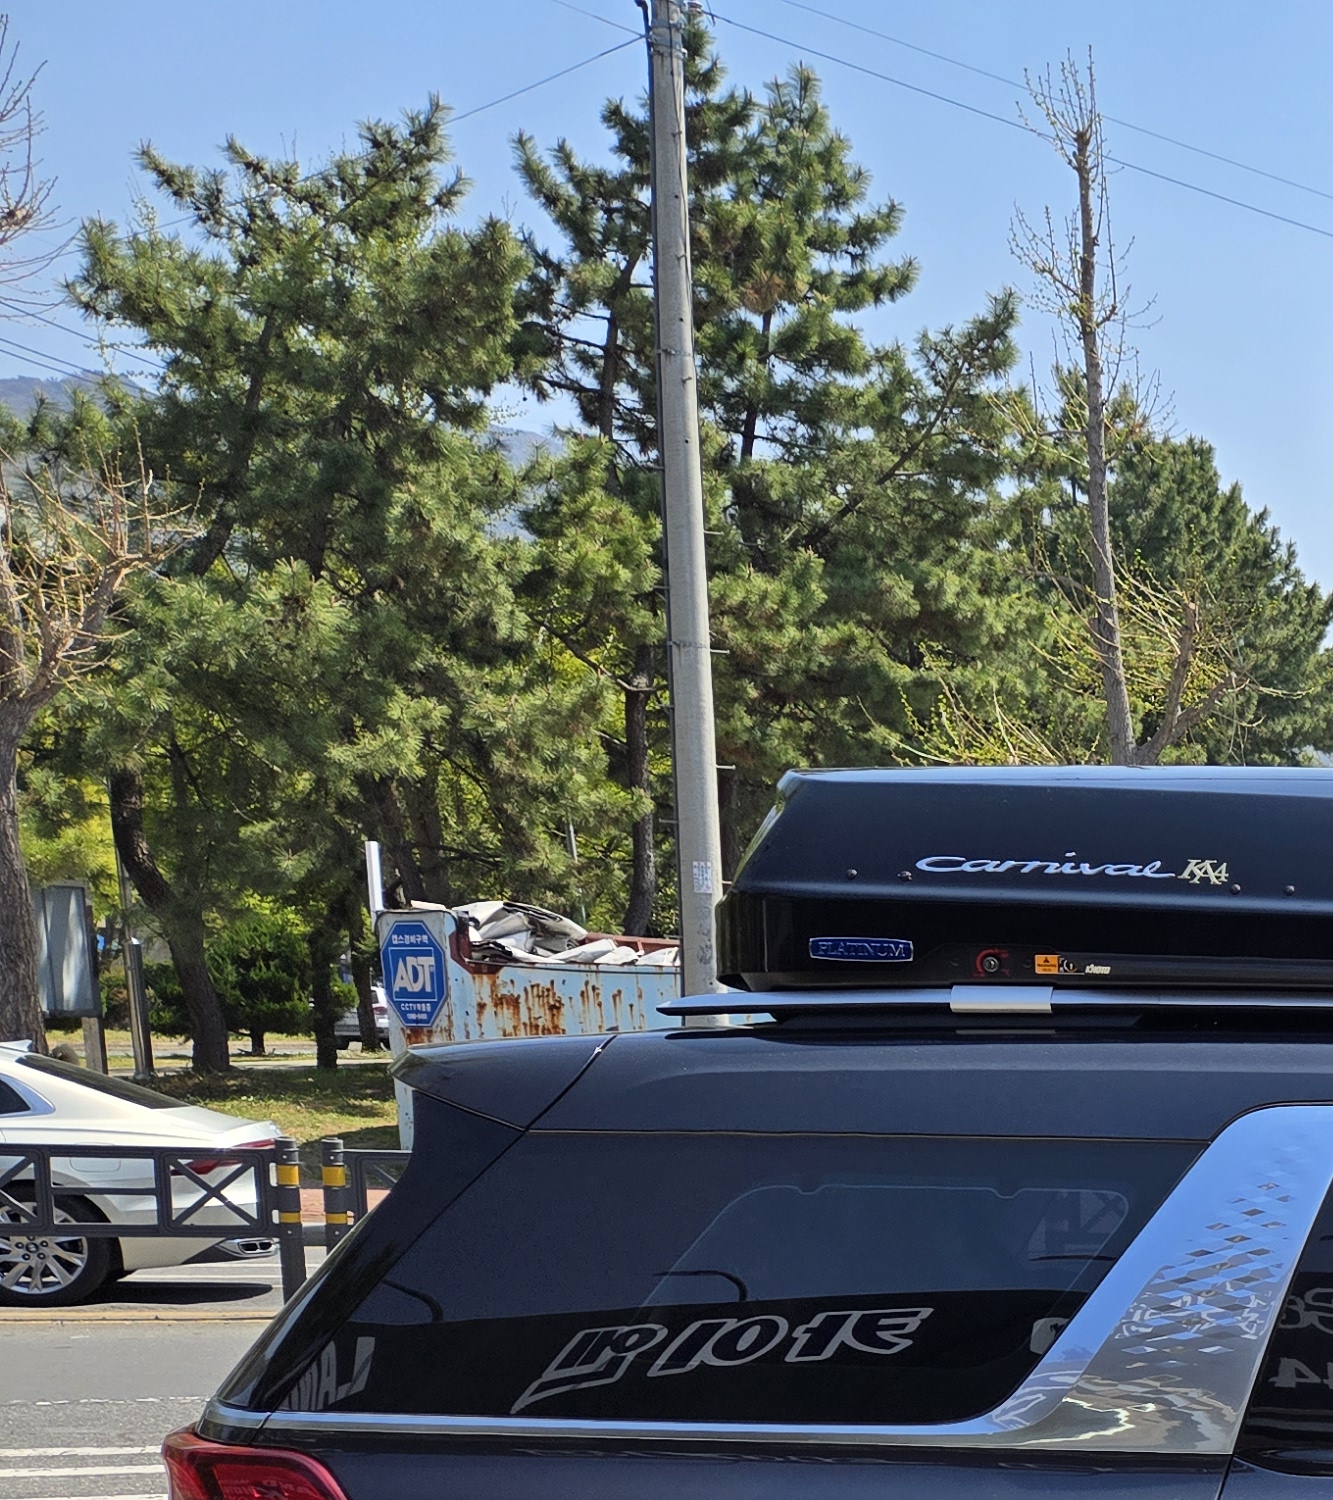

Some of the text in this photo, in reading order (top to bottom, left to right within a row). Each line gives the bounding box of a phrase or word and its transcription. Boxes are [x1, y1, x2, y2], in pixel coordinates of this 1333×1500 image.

[915, 851, 1230, 885] Carnival KA4
[816, 940, 906, 958] PLATINUM
[393, 955, 435, 993] ADT
